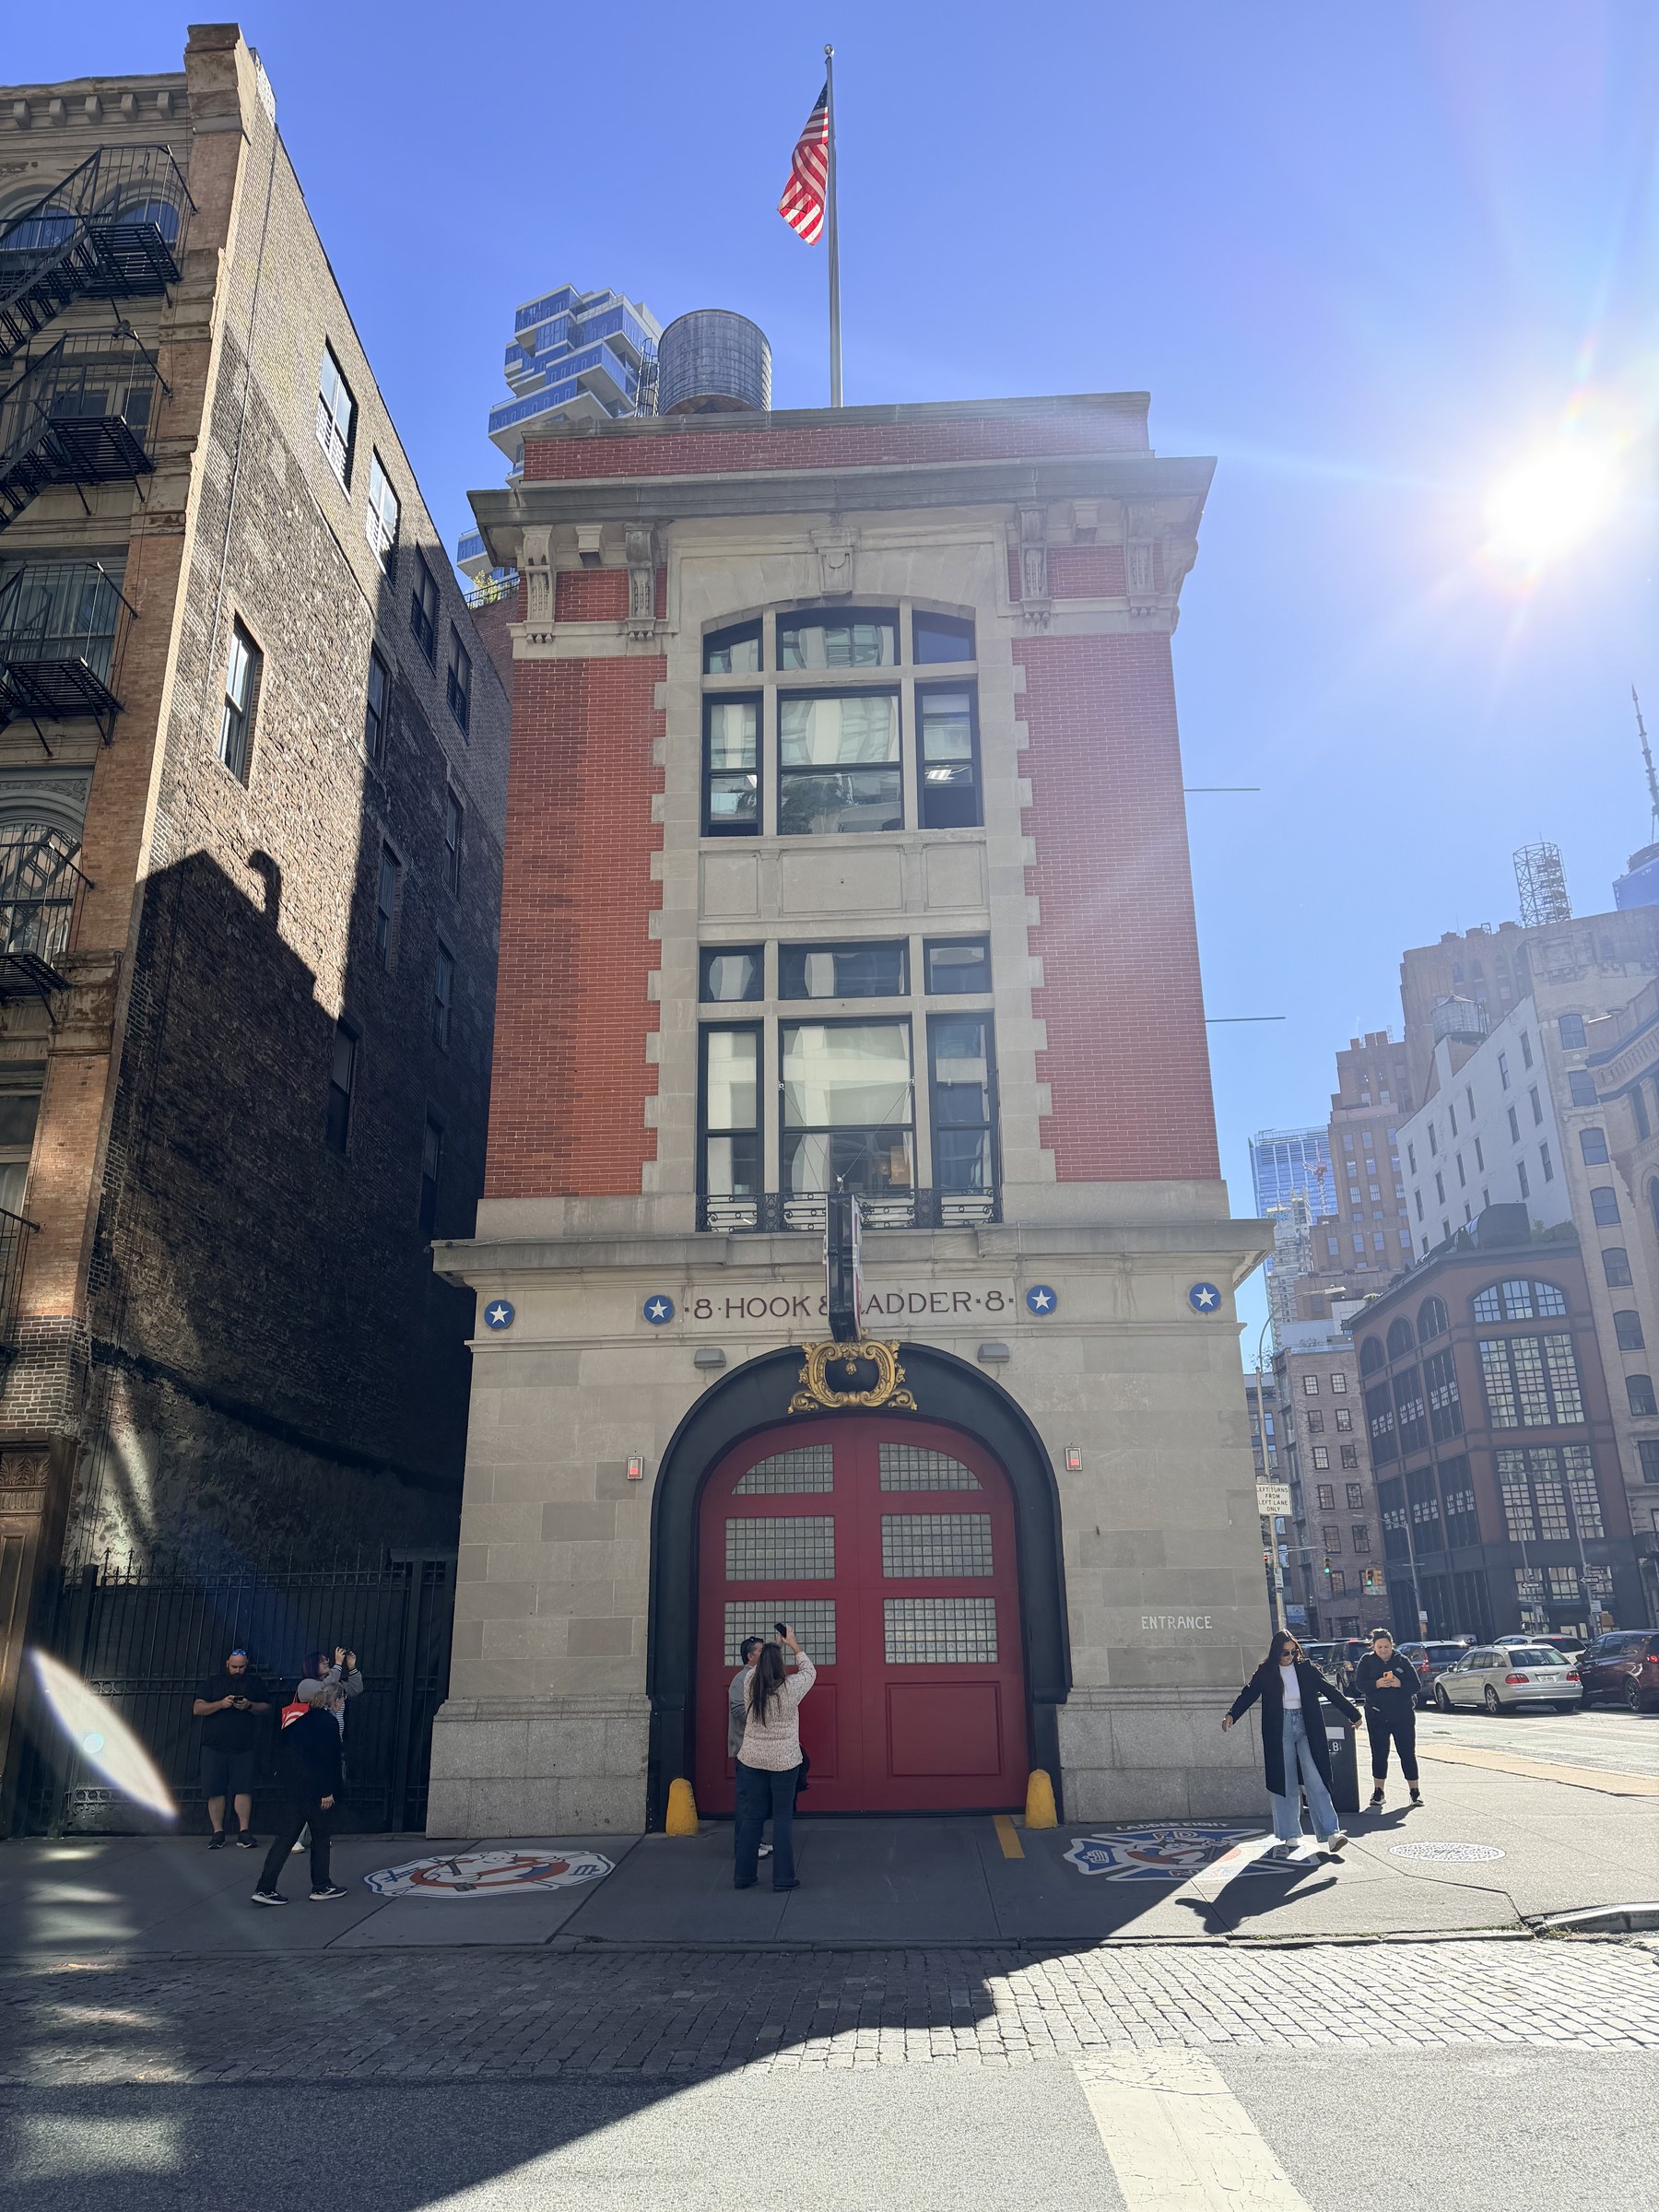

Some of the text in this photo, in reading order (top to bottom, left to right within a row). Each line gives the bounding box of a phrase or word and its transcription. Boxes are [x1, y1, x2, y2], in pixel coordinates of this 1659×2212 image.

[693, 1299, 713, 1319] 8
[724, 1295, 812, 1319] HOOK
[985, 1290, 1006, 1312] 8
[1141, 1616, 1213, 1630] ENTRANCE
[1115, 1821, 1180, 1831] LADDER
